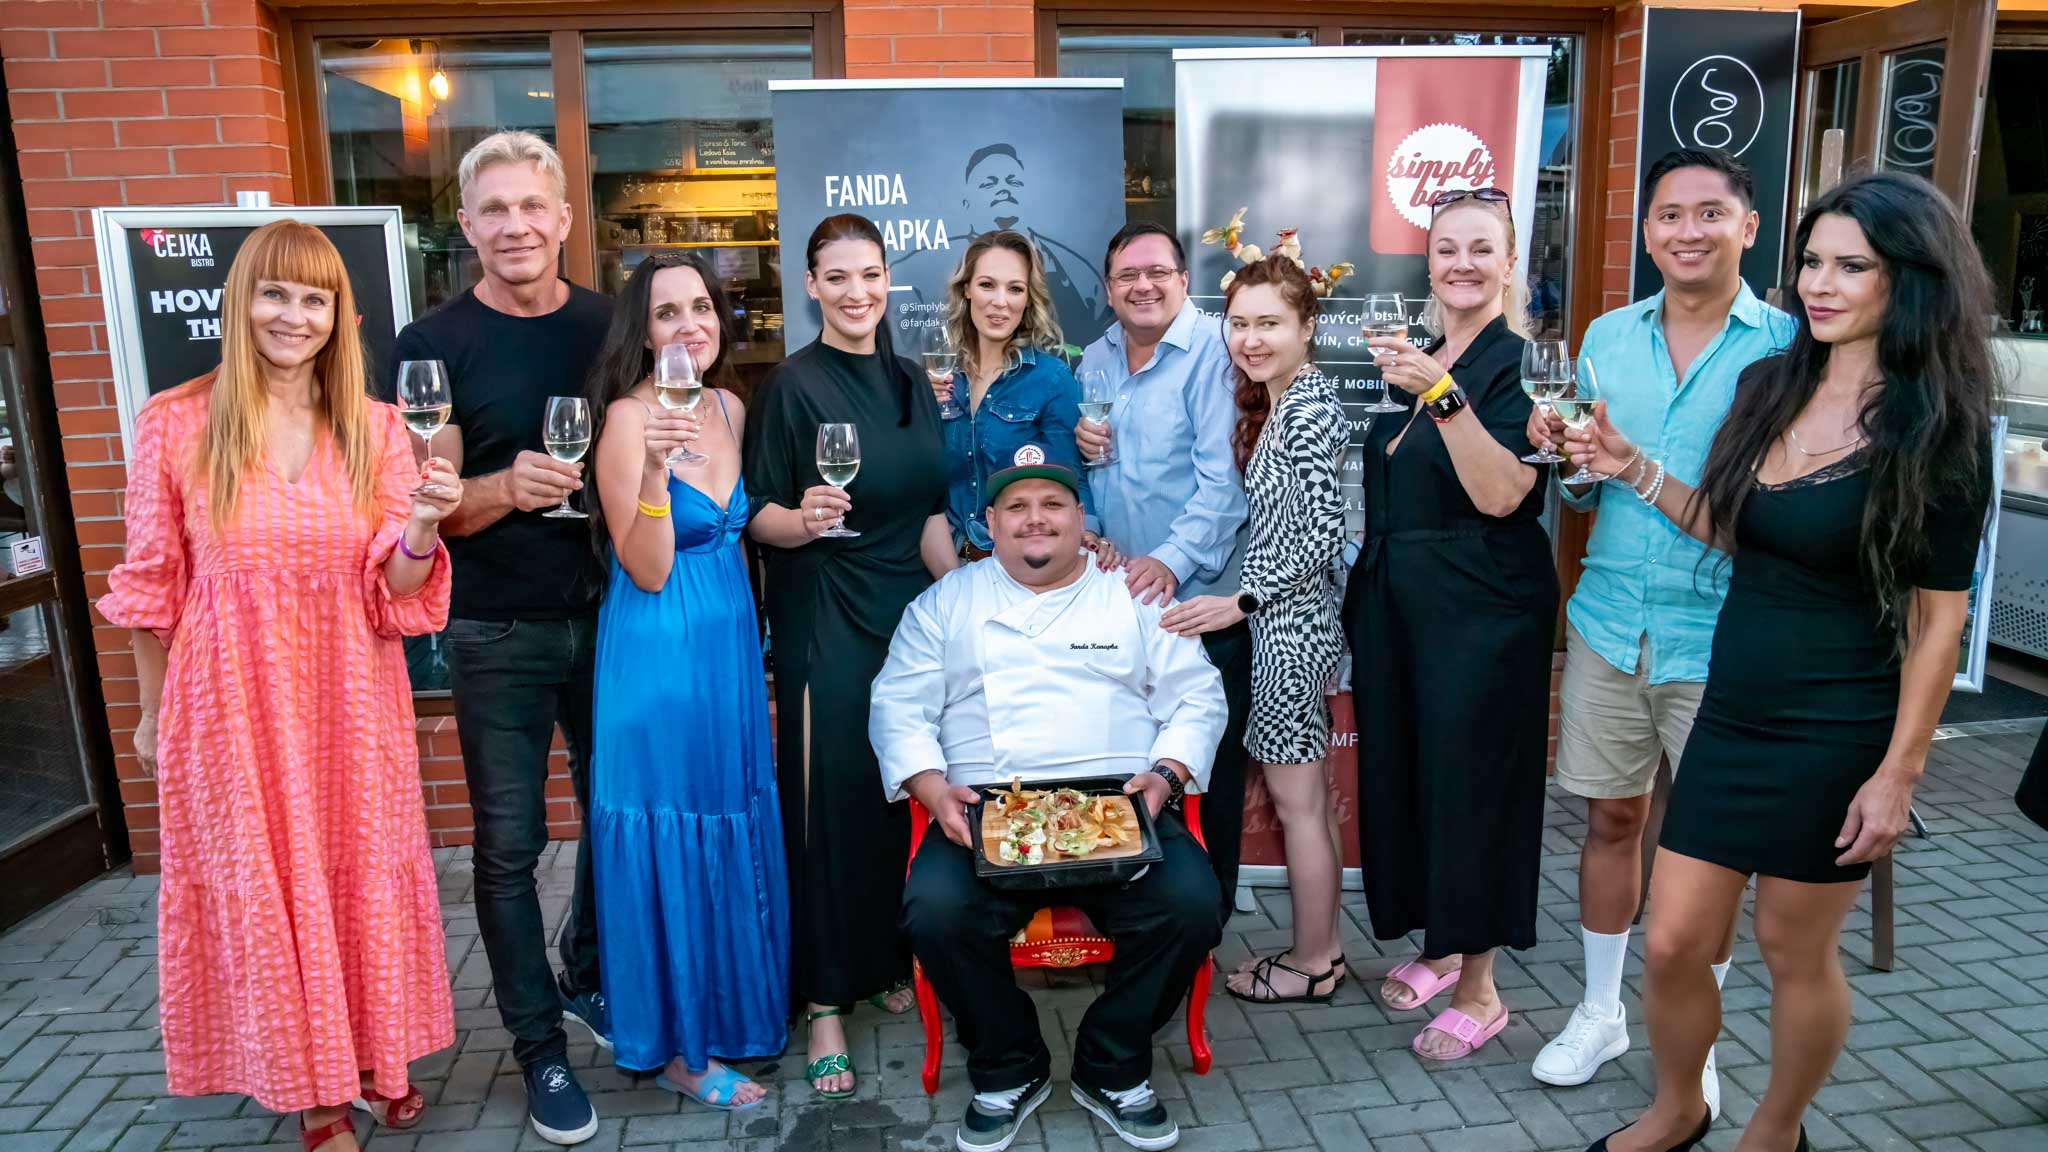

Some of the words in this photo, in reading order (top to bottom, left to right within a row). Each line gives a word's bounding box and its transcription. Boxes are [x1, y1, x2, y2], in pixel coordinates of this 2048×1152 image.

[1391, 148, 1495, 187] simply
[825, 173, 908, 207] FANDA
[152, 229, 213, 258] ČEJKA
[873, 219, 950, 251] APKA
[190, 258, 215, 267] BISTRO
[150, 283, 227, 314] HOV
[186, 318, 222, 337] TH
[1316, 310, 1369, 325] OVÝCH
[1314, 332, 1341, 349] VÍN,
